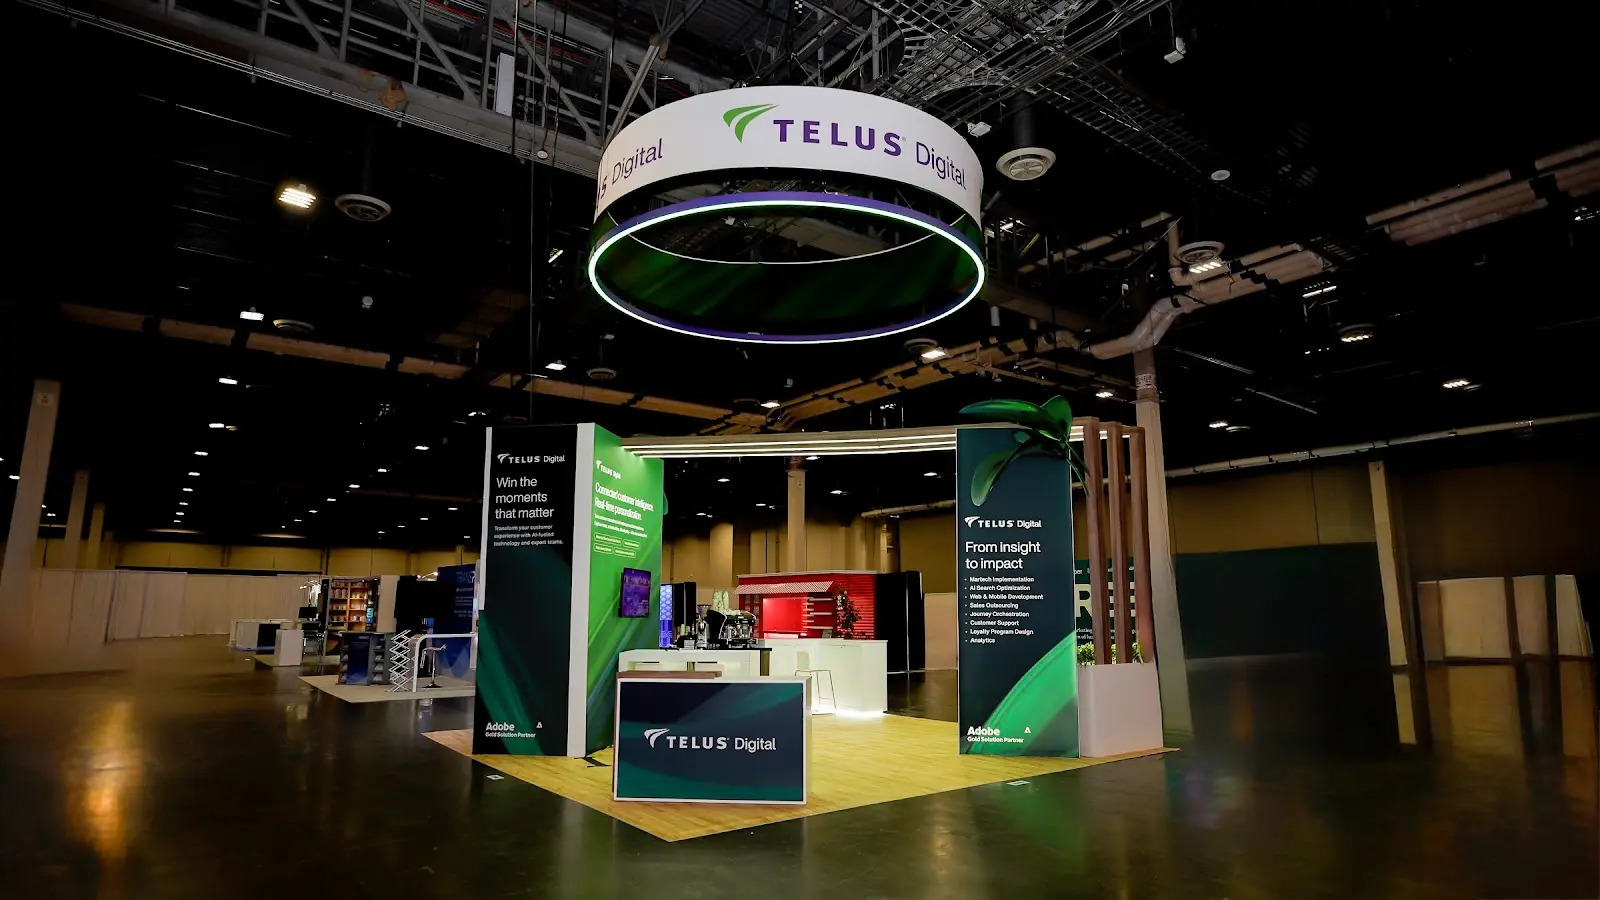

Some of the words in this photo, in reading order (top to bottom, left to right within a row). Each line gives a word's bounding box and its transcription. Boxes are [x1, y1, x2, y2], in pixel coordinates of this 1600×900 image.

[773, 119, 902, 157] TELUS
[915, 141, 966, 190] Digital
[612, 138, 663, 185] Digital
[508, 456, 541, 464] TELUS
[543, 455, 565, 464] Digital
[496, 477, 518, 488] Win
[519, 476, 538, 487] the
[495, 492, 548, 503] moments
[495, 508, 516, 519] that
[518, 508, 554, 518] matter
[977, 520, 1014, 528] TELUS
[1016, 520, 1042, 529] Digital
[965, 542, 998, 553] From
[999, 541, 1041, 555] insight
[965, 558, 978, 569] to
[980, 558, 1023, 571] impact
[992, 576, 1034, 584] Implementation
[985, 602, 1019, 610] Outsourcing
[485, 721, 516, 731] Adobe
[967, 726, 1001, 736] Adobe
[666, 736, 729, 750] TELUS
[734, 737, 777, 753] Digital
